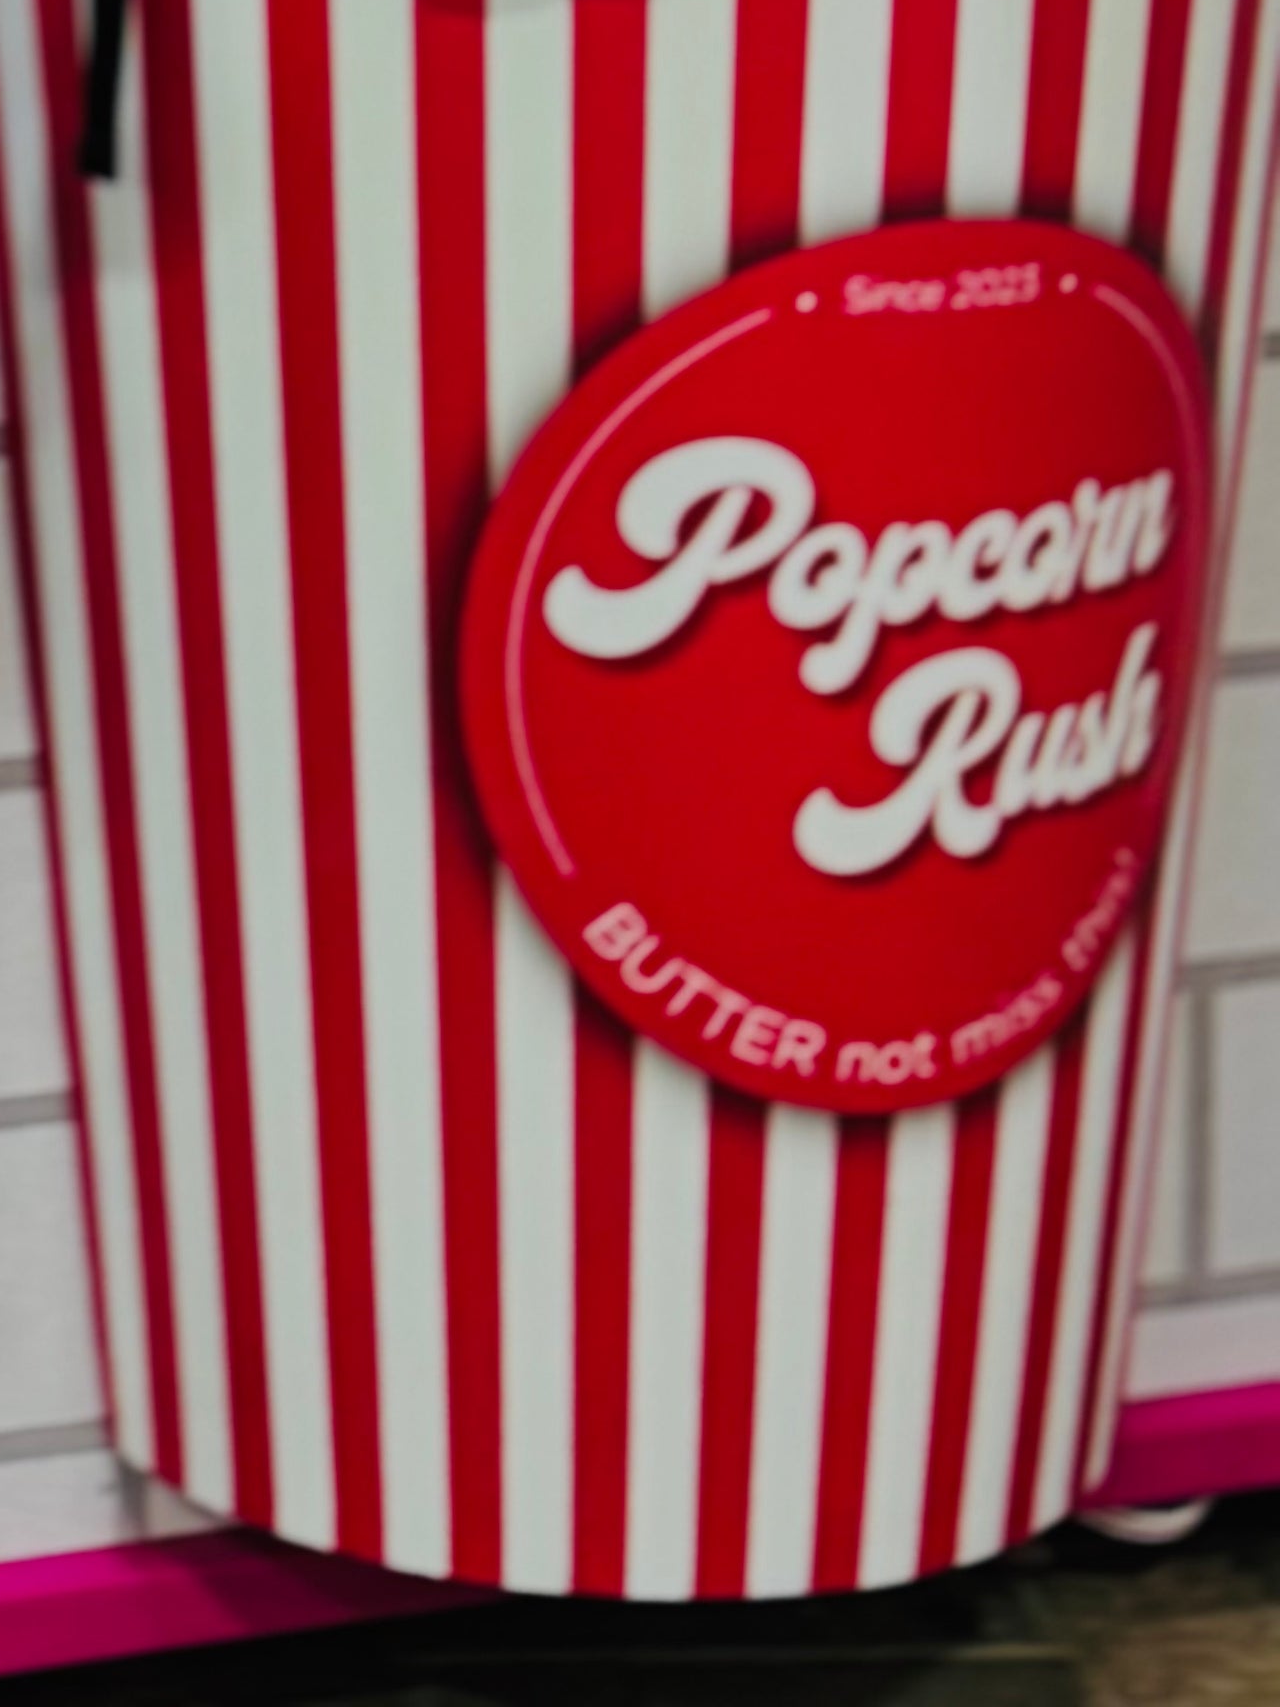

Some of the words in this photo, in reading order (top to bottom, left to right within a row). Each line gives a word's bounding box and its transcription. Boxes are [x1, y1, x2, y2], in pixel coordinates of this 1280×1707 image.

[844, 275, 945, 315] Since
[543, 436, 1171, 694] Popcorn
[794, 622, 1160, 876] Rush
[582, 901, 827, 1076] BUTTER
[836, 1032, 936, 1084] not
